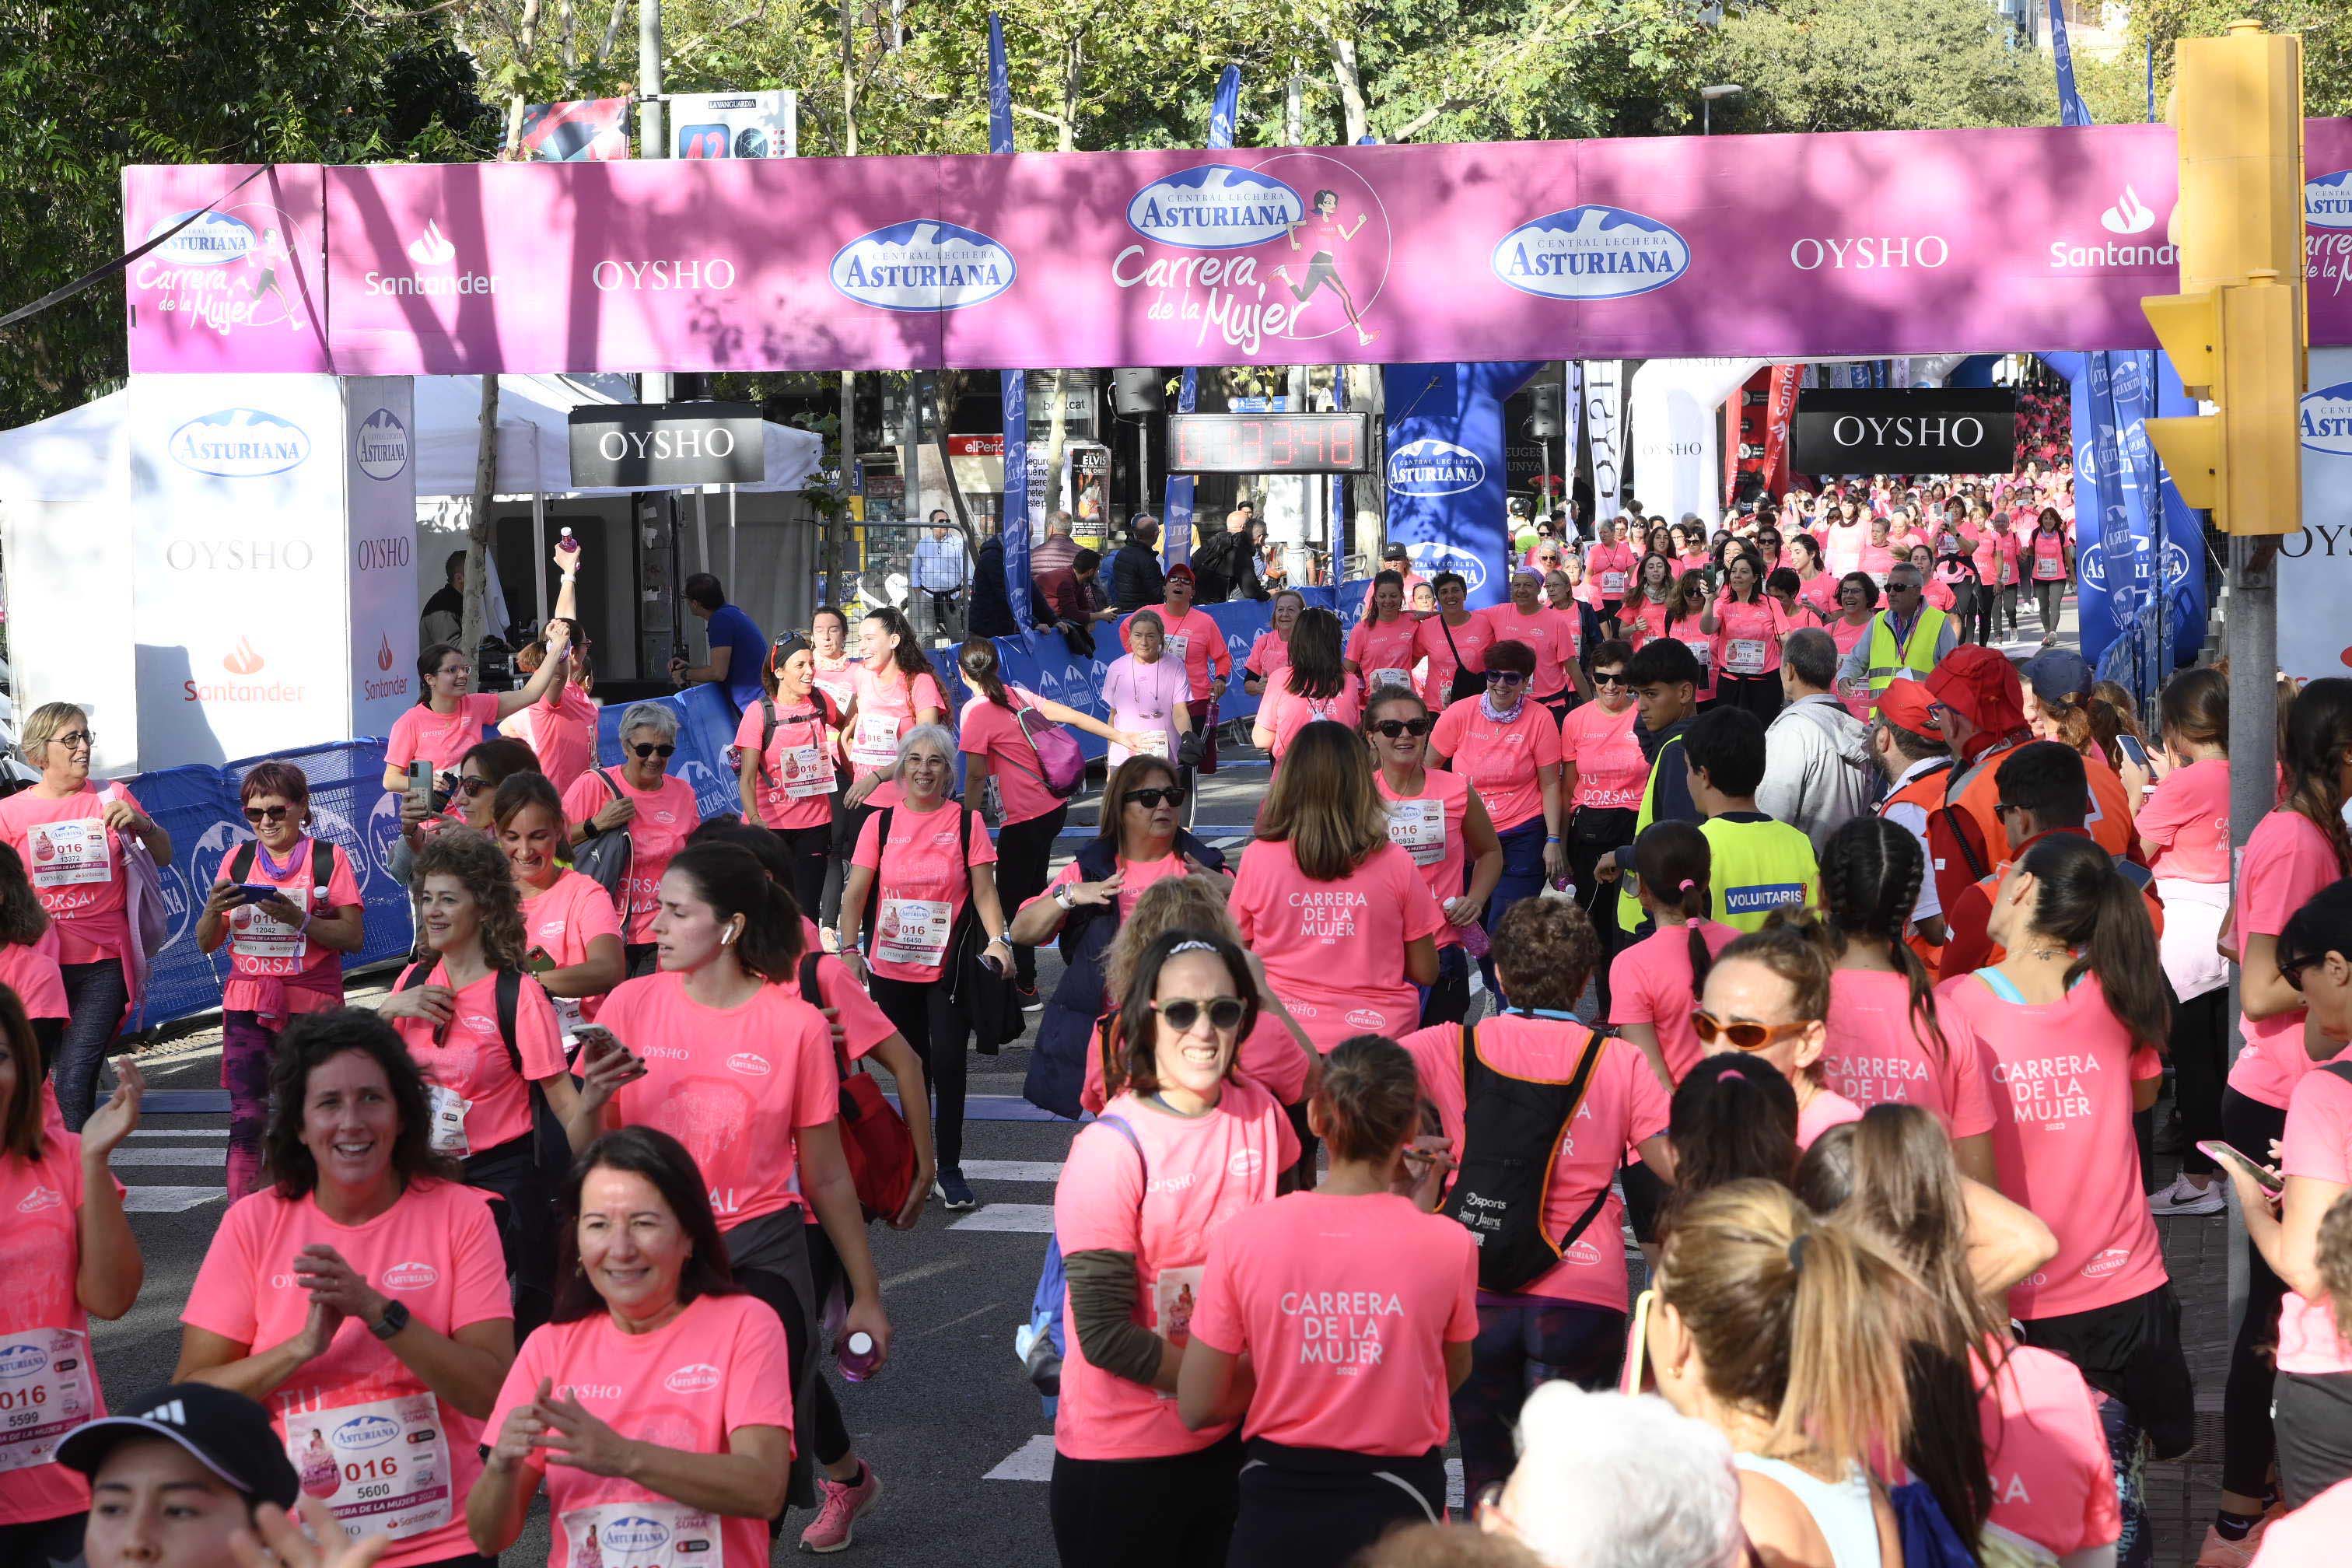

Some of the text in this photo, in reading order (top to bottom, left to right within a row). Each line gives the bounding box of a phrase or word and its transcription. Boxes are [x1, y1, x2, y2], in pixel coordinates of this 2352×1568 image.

[1167, 191, 1286, 202] CENTRAL LECHERA
[1140, 197, 1290, 229] ASTURIANA
[1538, 236, 1668, 248] CENTRAL LECHERA
[1791, 236, 1948, 269] OYSHO
[872, 250, 996, 261] CENTRAL LECHERA
[1111, 244, 1258, 288] Carrera
[1509, 242, 1675, 276] ASTURIANA
[136, 261, 228, 291] Carrera
[593, 260, 735, 291] OYSHO
[845, 254, 1002, 287] ASTURIANA
[2322, 257, 2336, 278] la
[365, 271, 499, 295] Santander
[158, 293, 176, 312] de
[189, 288, 262, 336] Mujer
[1147, 282, 1312, 355] de la Mujer
[1834, 415, 1983, 447] OYSHO
[182, 434, 300, 460] ASTURIANA
[360, 435, 405, 463] ASTURIANA
[599, 428, 734, 461] OYSHO
[1082, 455, 1107, 465] ELVIS
[1390, 464, 1478, 484] ASTURIANA
[166, 540, 313, 571] OYSHO
[358, 536, 409, 571] OYSHO
[184, 680, 305, 702] Santander
[365, 677, 408, 702] Santander
[800, 764, 817, 773] 016
[1391, 825, 1417, 836] 016
[57, 843, 82, 854] 016
[1288, 891, 1368, 907] CARRERA
[1727, 891, 1803, 908] VOLUNTARIS
[1304, 907, 1353, 922] DE LA
[901, 925, 926, 935] 016
[1300, 922, 1356, 936] MUJER
[642, 1045, 689, 1060] OYSHO
[1825, 1056, 1930, 1082] CARRERA
[1993, 1053, 2101, 1083] CARRERA
[1844, 1079, 1908, 1101] DE LA
[2014, 1077, 2085, 1102] DE LA
[2013, 1097, 2092, 1123] MUJER
[1476, 1196, 1507, 1209] sports
[1281, 1291, 1405, 1317] CARRERA
[1304, 1317, 1380, 1340] DE LA
[1300, 1341, 1383, 1366] MUJER
[9, 1411, 40, 1427] 5599
[337, 1428, 395, 1445] ASTURIANA
[345, 1456, 398, 1482] 016
[357, 1483, 390, 1500] 5600
[358, 1504, 372, 1515] DE
[374, 1503, 387, 1513] LA
[387, 1496, 417, 1512] MUJER
[398, 1508, 442, 1528] Santander
[674, 1519, 709, 1530] SUMA
[605, 1527, 665, 1545] ASTURIANA
